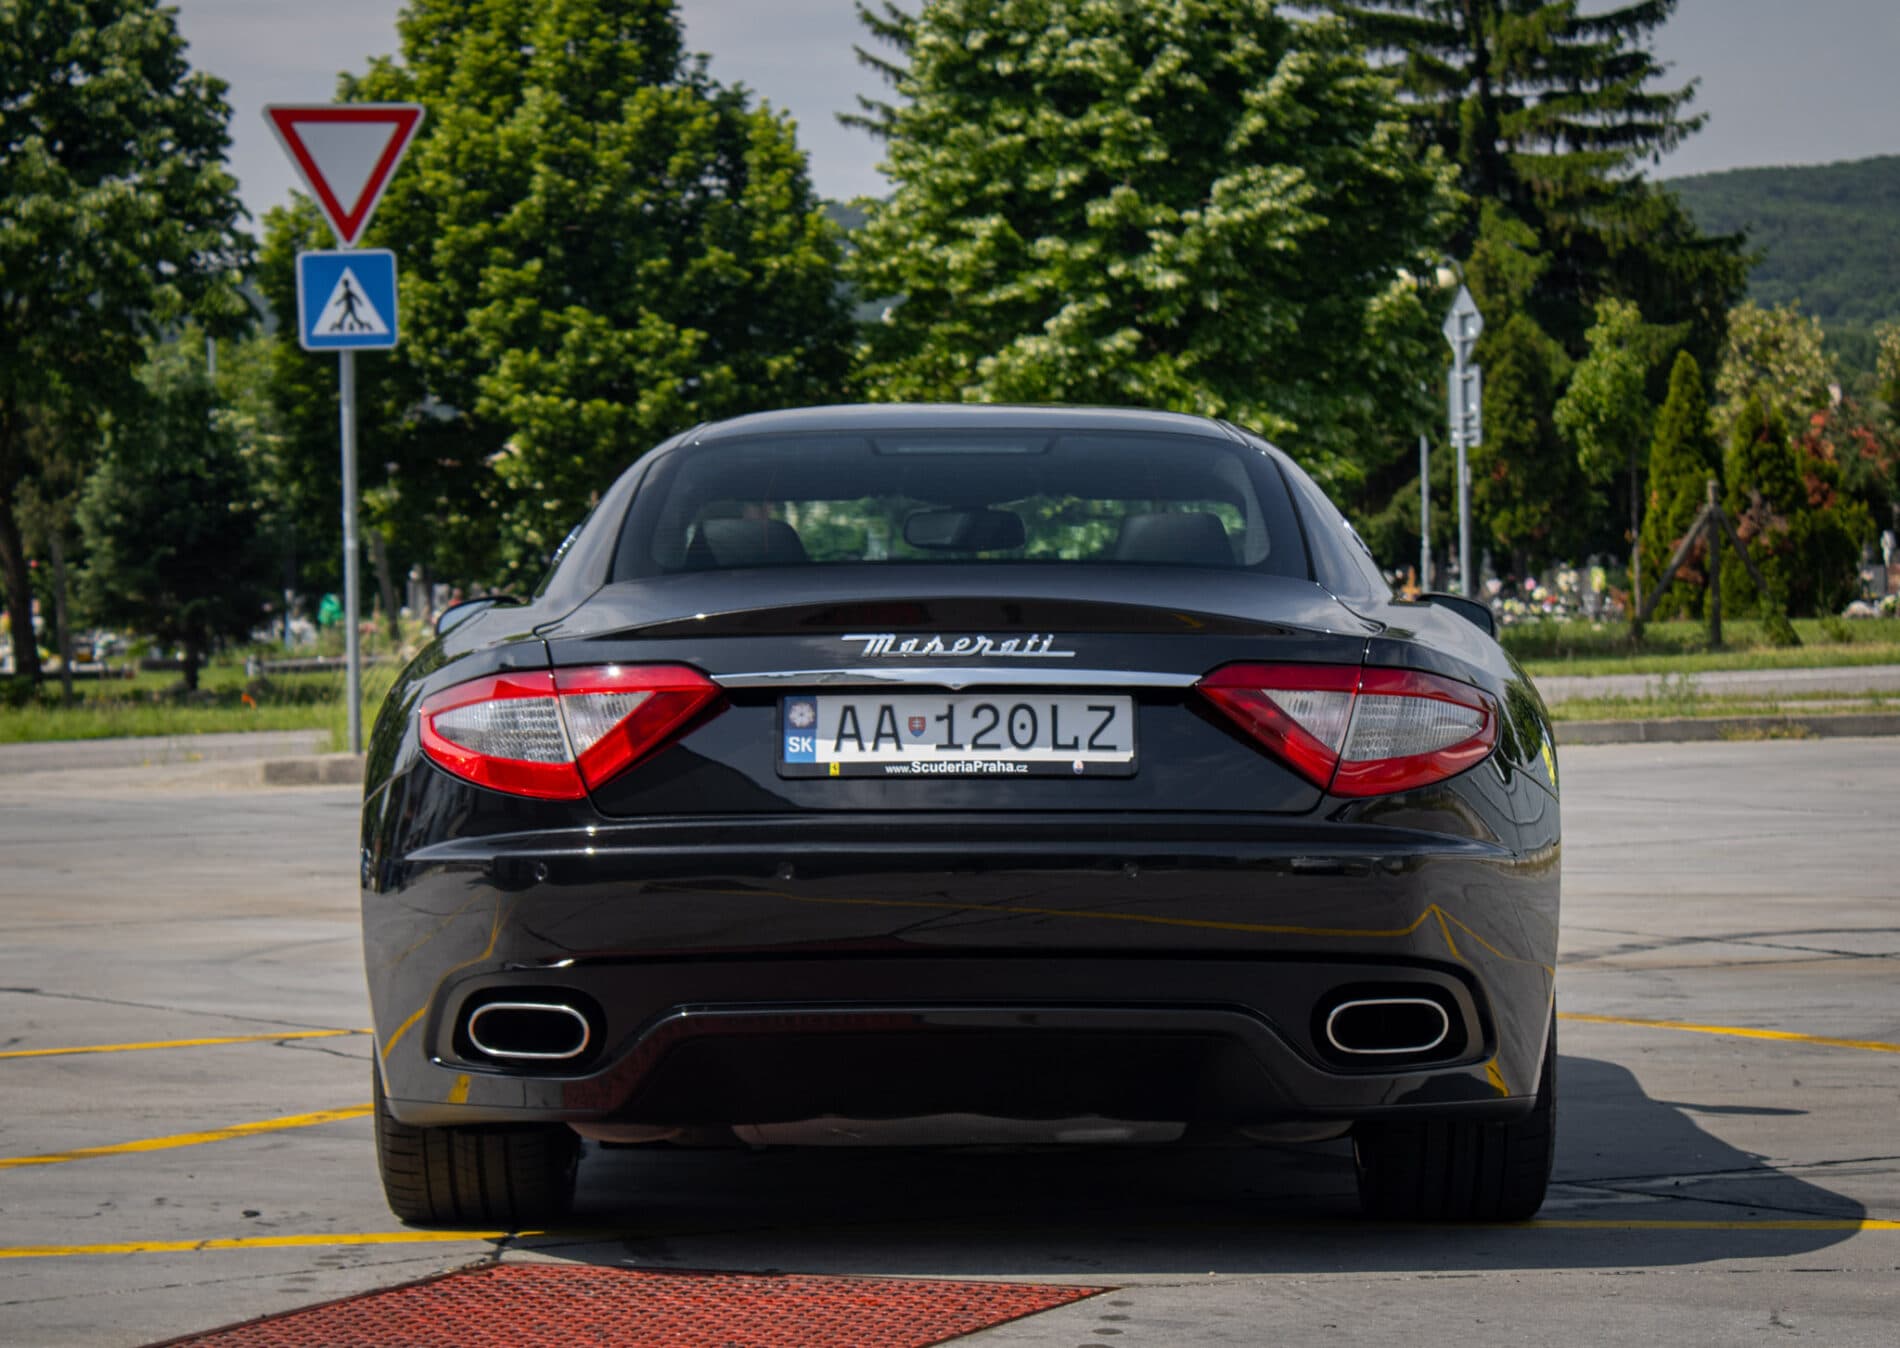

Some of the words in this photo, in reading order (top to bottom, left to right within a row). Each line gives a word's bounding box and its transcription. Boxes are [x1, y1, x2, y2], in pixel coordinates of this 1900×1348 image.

[841, 634, 1076, 657] Maserati
[833, 704, 903, 752] AA
[935, 703, 1118, 751] 120LZ
[788, 736, 814, 753] SK
[885, 760, 1029, 774] www.ScuderiaPraha.cz
